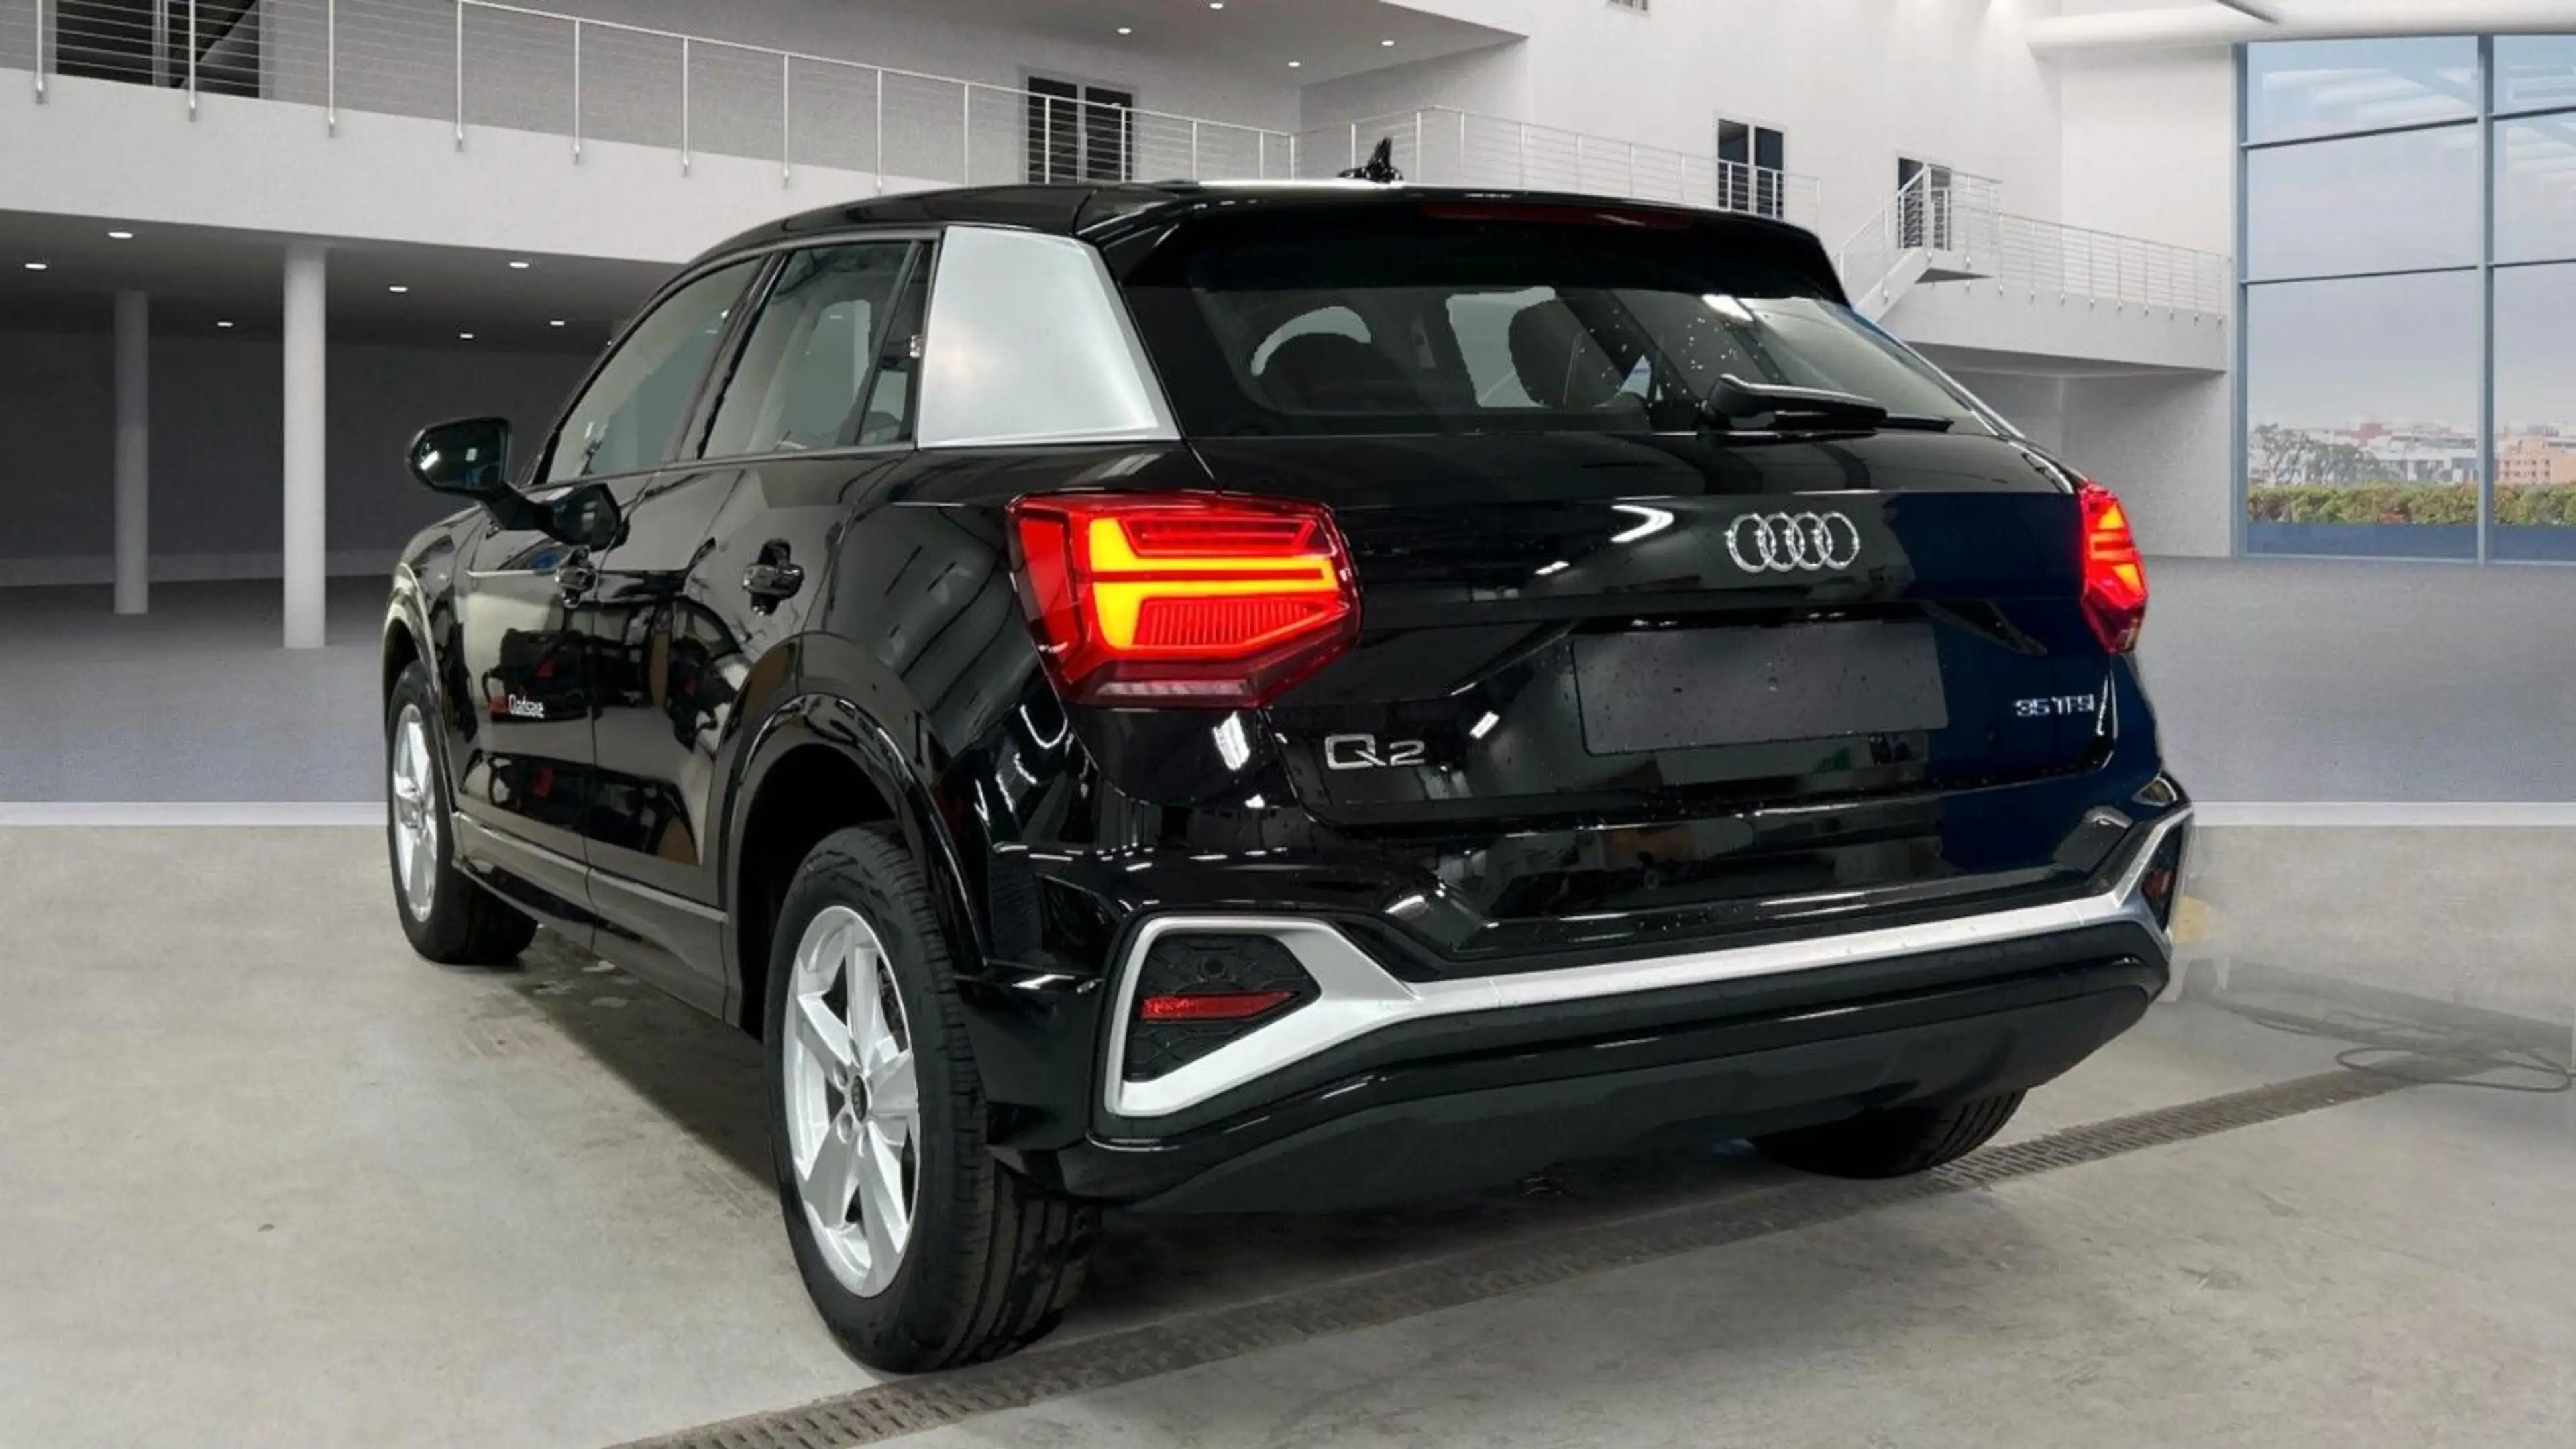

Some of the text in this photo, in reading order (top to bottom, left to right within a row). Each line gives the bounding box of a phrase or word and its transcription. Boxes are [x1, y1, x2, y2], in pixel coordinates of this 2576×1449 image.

[2015, 693, 2094, 717] 35 TFSI
[1324, 733, 1425, 770] Q2
